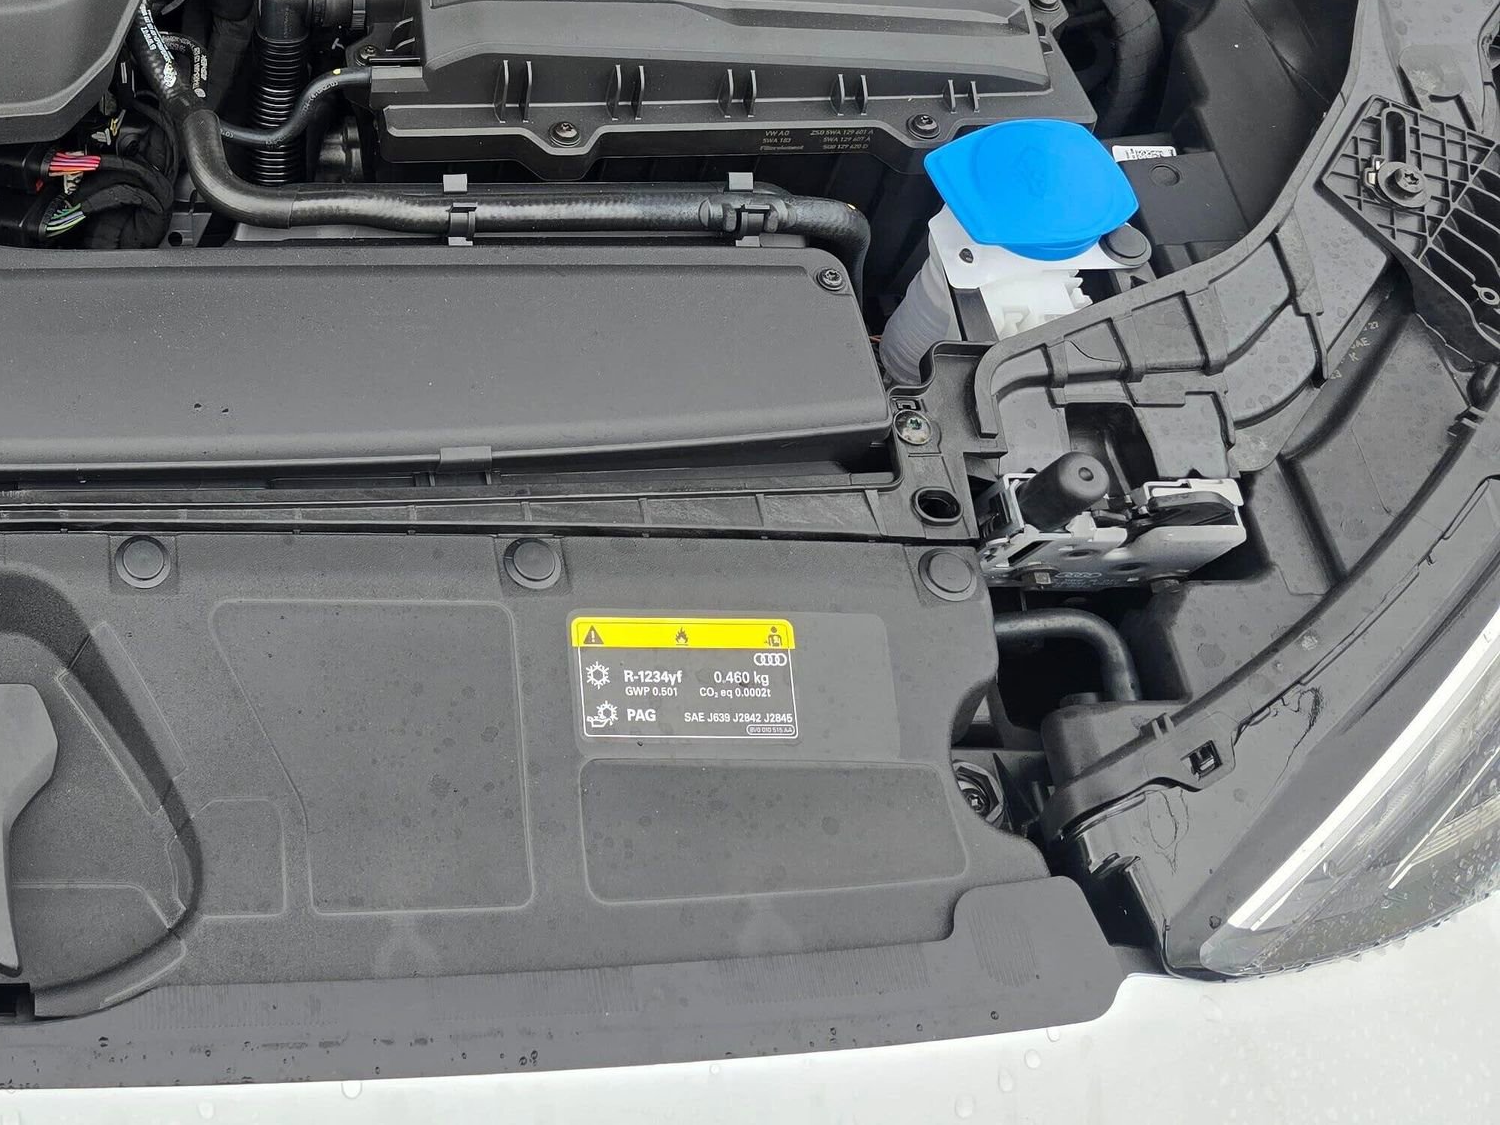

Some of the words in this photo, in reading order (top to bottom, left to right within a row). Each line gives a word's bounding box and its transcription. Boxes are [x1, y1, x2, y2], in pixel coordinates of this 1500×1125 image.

[624, 670, 683, 686] R-1234yf
[714, 671, 750, 683] 0.460
[754, 671, 769, 686] kg
[625, 686, 650, 696] GWP
[652, 687, 678, 696] 0.501
[720, 689, 733, 698] eq
[735, 688, 771, 697] 0.0002t
[627, 708, 656, 721] PAG
[684, 713, 705, 722] SAE
[707, 713, 731, 722] J639
[733, 713, 761, 723] J2842
[764, 713, 793, 723] J2845
